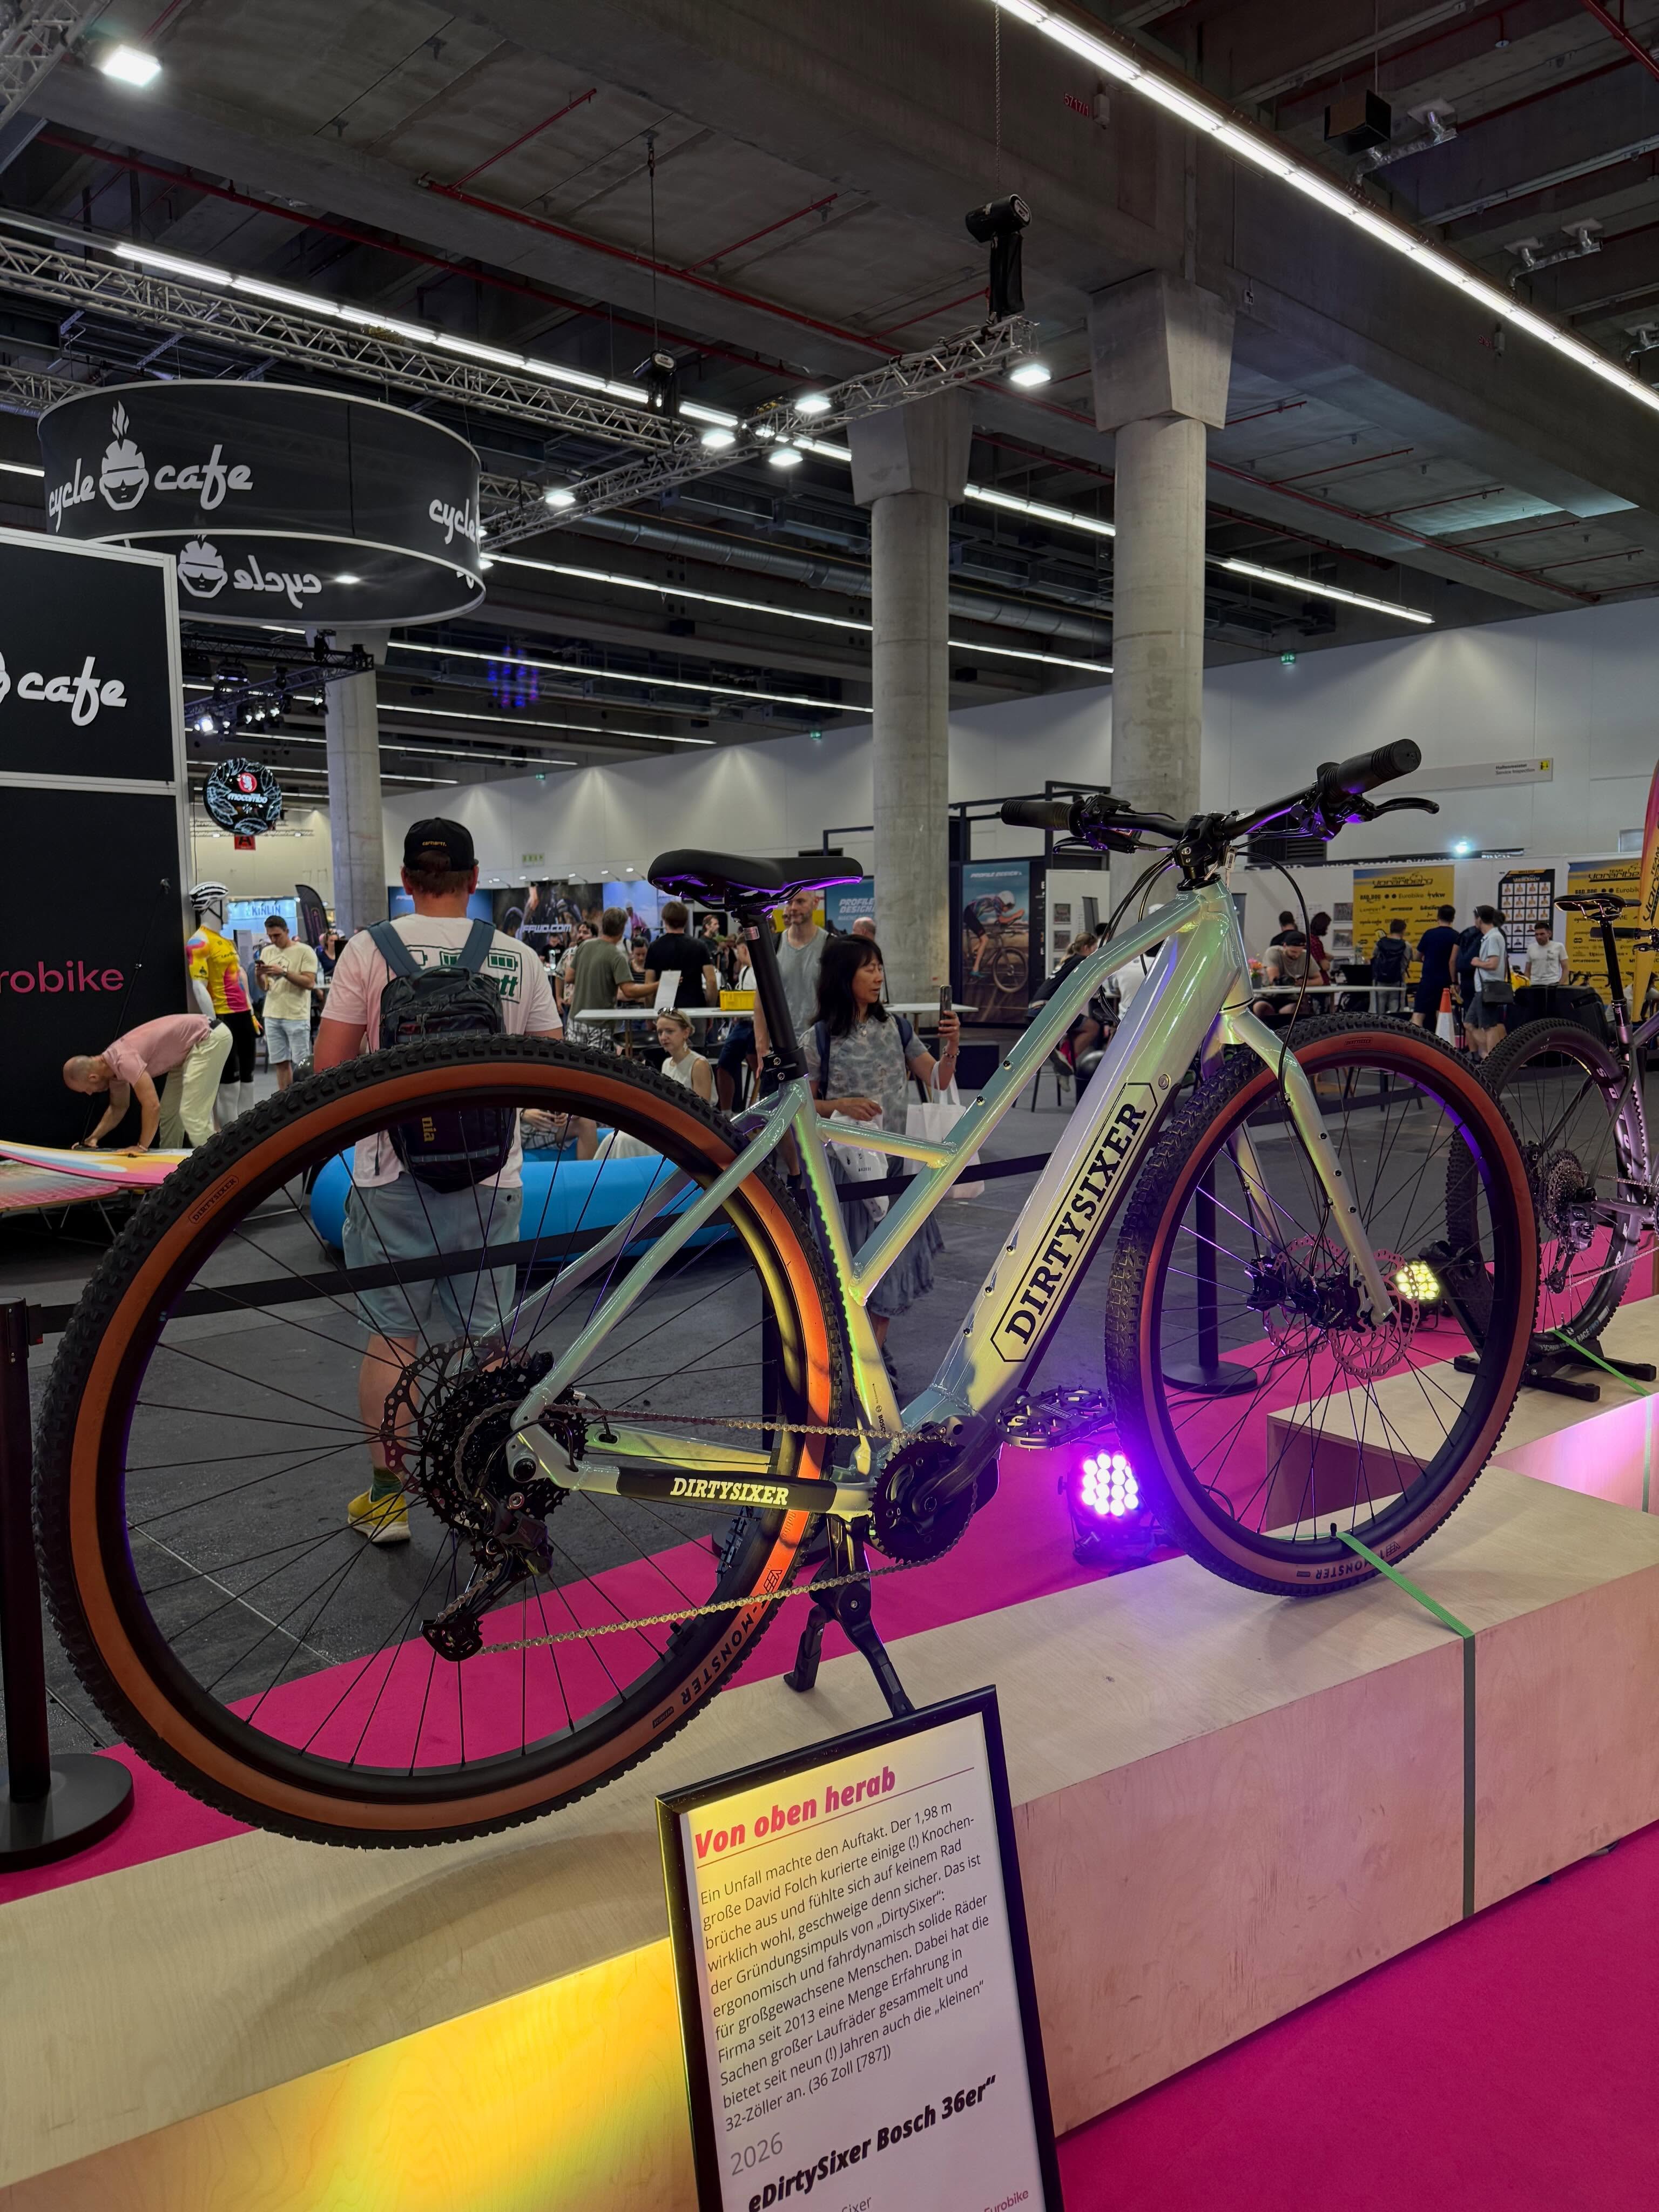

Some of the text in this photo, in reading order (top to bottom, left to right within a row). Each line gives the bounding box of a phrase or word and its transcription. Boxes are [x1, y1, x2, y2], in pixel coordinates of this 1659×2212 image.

[1064, 93, 1089, 117] 5717/1
[49, 444, 254, 533] cycle cafe
[429, 498, 479, 544] cycle
[17, 656, 128, 726] cafe
[839, 898, 875, 907] PROFILE
[839, 906, 873, 914] DESIGN
[193, 1178, 237, 1221] DIRTYSIXER
[1005, 1103, 1148, 1345] DIRTYSIXER
[670, 1477, 790, 1506] DIRTYSIXER
[695, 1765, 895, 1858] Von oben herab
[701, 1803, 952, 1905] Ein Unfall machte den Auftakt. Der 1,98 m
[703, 1817, 974, 1931] große David Folch kurierte einige (!) Knochen-
[706, 1838, 961, 1950] brüche aus und fühlte sich auf keinem Rad
[707, 1854, 981, 1972] wirklich wohl, geschweige denn sicher. Das ist
[711, 1977, 732, 1994] der
[737, 1928, 848, 1983] Gründungsimpuls
[851, 1920, 873, 1937] von
[713, 1894, 987, 2017] ergonomisch und fahrdynamisch solide Räder
[716, 1916, 989, 2040] für großgewachsene Menschen. Dabei hat die
[718, 1948, 962, 2063] Firma seit 2013 eine Menge Erfahrung in
[720, 1964, 968, 2086] Sachen großer Laufräder gesammelt und
[723, 2081, 761, 2108] bietet
[764, 2069, 787, 2089] seit
[790, 2055, 822, 2078] neun
[825, 2045, 837, 2063] (!)
[839, 2029, 879, 2059] Jahren
[882, 2013, 910, 2035] auch
[914, 2006, 931, 2021] die
[726, 2044, 891, 2132] 32-Zöller an. (36 Zoll [787])
[731, 2132, 783, 2175] 2026
[748, 2139, 872, 2212] eDirtySixer
[876, 2104, 936, 2152] Bosch
